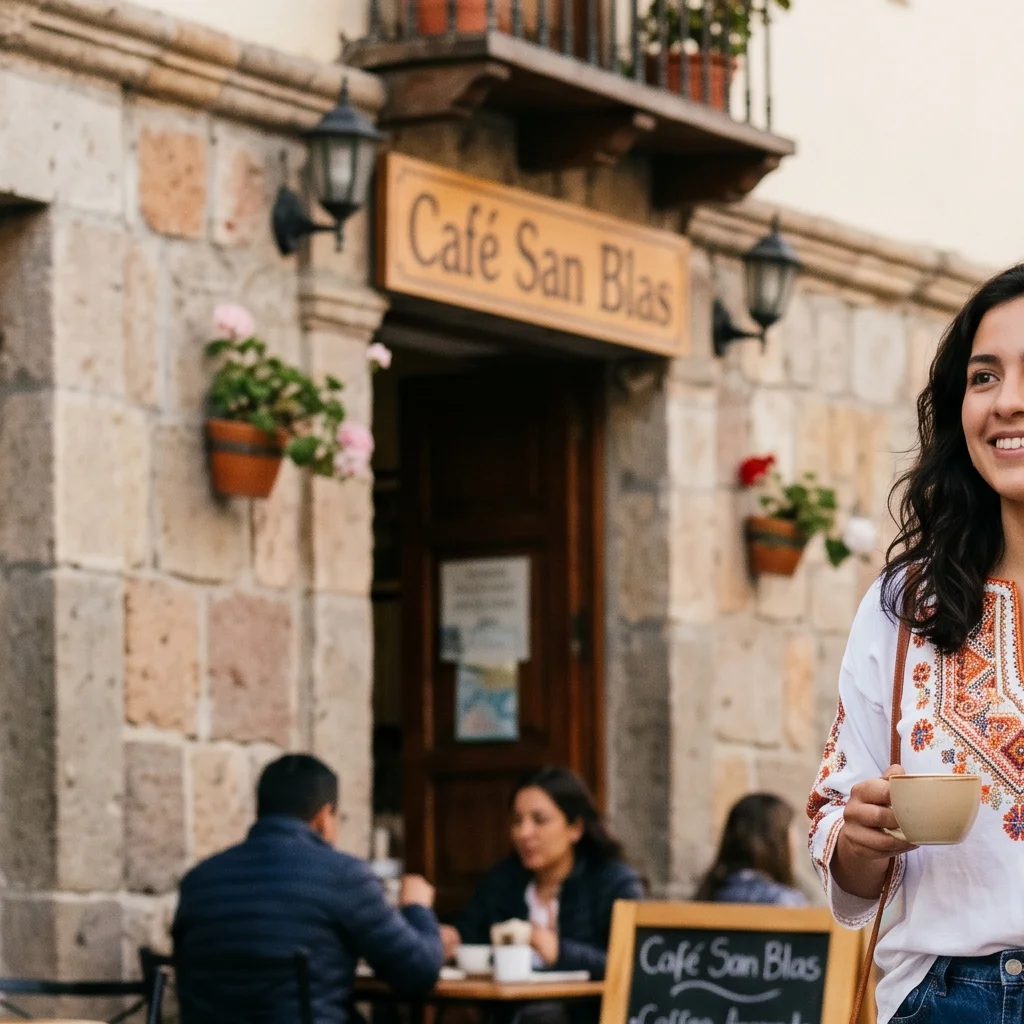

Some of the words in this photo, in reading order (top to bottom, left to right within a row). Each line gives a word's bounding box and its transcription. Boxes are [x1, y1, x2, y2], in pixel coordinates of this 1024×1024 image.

[409, 191, 501, 283] Café
[515, 219, 585, 305] San
[600, 242, 673, 327] Blas
[639, 934, 706, 982] Café
[707, 936, 760, 979] San
[762, 940, 822, 982] Blas
